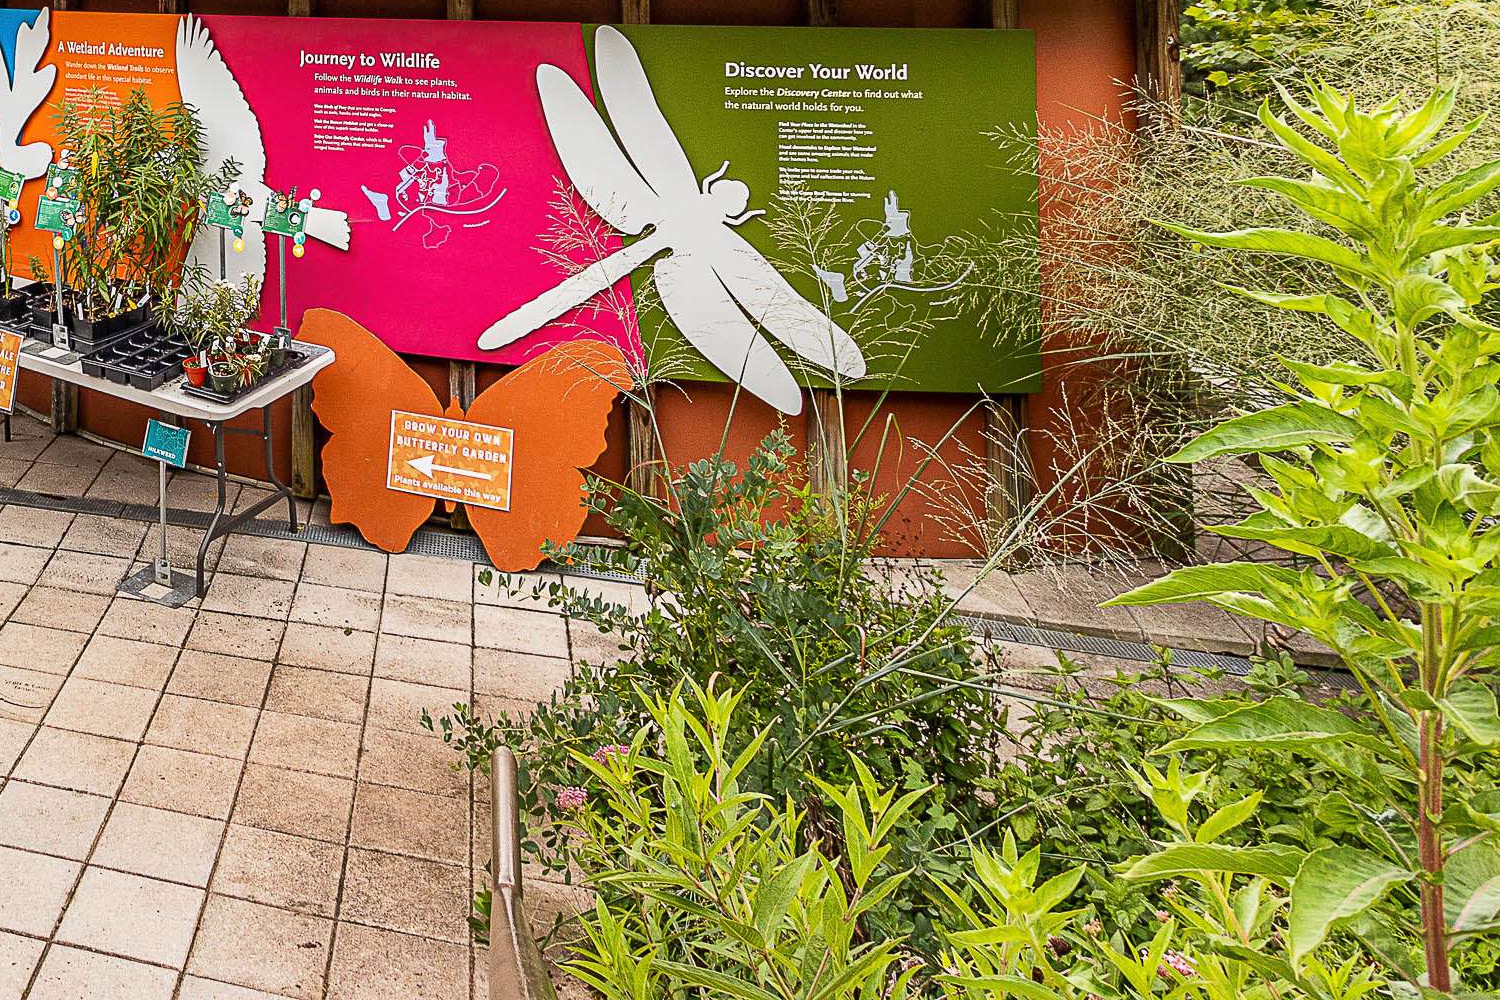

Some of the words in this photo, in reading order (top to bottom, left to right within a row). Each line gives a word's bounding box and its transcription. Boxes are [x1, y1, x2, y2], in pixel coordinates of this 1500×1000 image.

[58, 41, 65, 53] A
[68, 41, 106, 55] Wetland
[108, 43, 165, 58] Adventure
[107, 63, 129, 71] Wetland
[129, 64, 144, 72] Trails
[300, 50, 356, 69] Journey
[360, 53, 376, 66] to
[379, 52, 441, 68] Wildlife
[88, 73, 96, 81] life
[131, 76, 154, 84] habitat.
[724, 62, 805, 78] Discover
[809, 64, 851, 79] Your
[856, 64, 909, 80] World
[314, 72, 338, 82] Follow
[339, 74, 352, 82] the
[353, 74, 382, 86] Wildlife
[384, 76, 403, 84] Walk
[430, 78, 458, 88] plants,
[314, 86, 343, 95] animals
[345, 87, 359, 96] and
[360, 87, 380, 97] birds
[382, 88, 390, 97] in
[391, 89, 410, 98] their
[411, 90, 440, 99] natural
[441, 91, 473, 100] habitat.
[724, 86, 758, 98] Explore
[760, 87, 774, 96] the
[776, 88, 819, 99] Discovery
[821, 88, 851, 98] Center
[852, 90, 862, 98] to
[864, 89, 882, 99] find
[883, 91, 899, 99] out
[901, 90, 924, 99] what
[724, 100, 739, 110] the
[741, 101, 773, 110] natural
[775, 101, 801, 111] world
[802, 102, 828, 112] holds
[830, 102, 843, 112] for
[844, 105, 865, 114] you.
[405, 420, 436, 434] GROW
[442, 427, 470, 440] YOUR
[474, 432, 501, 445] OWN
[148, 446, 176, 459] MILKWEED
[397, 436, 458, 455] BUTTERFLY
[462, 448, 507, 464] GARDEN
[394, 474, 420, 486] Plants
[422, 481, 462, 495] available
[464, 488, 480, 498] this
[483, 493, 501, 503] way
